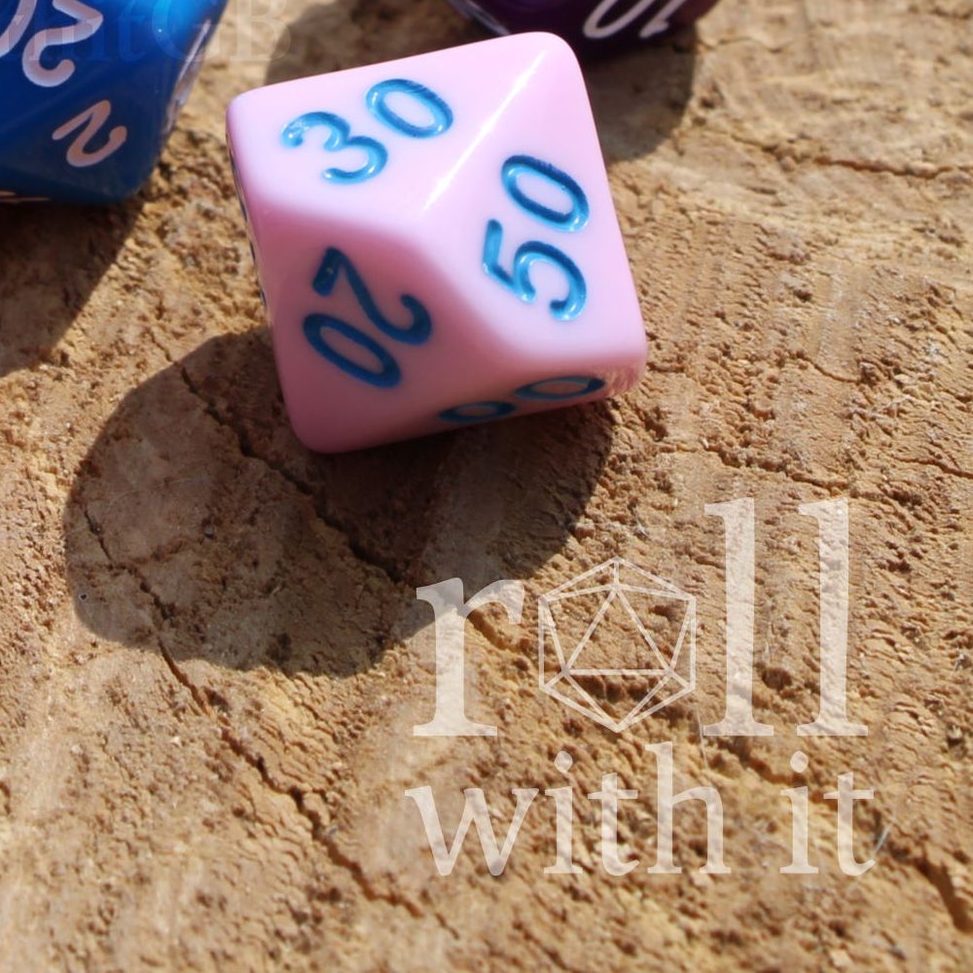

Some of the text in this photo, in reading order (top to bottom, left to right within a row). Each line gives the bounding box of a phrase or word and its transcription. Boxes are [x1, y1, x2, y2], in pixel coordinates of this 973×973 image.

[51, 100, 127, 168] 2
[281, 78, 454, 185] 30
[482, 154, 590, 322] 50
[302, 245, 433, 389] 20
